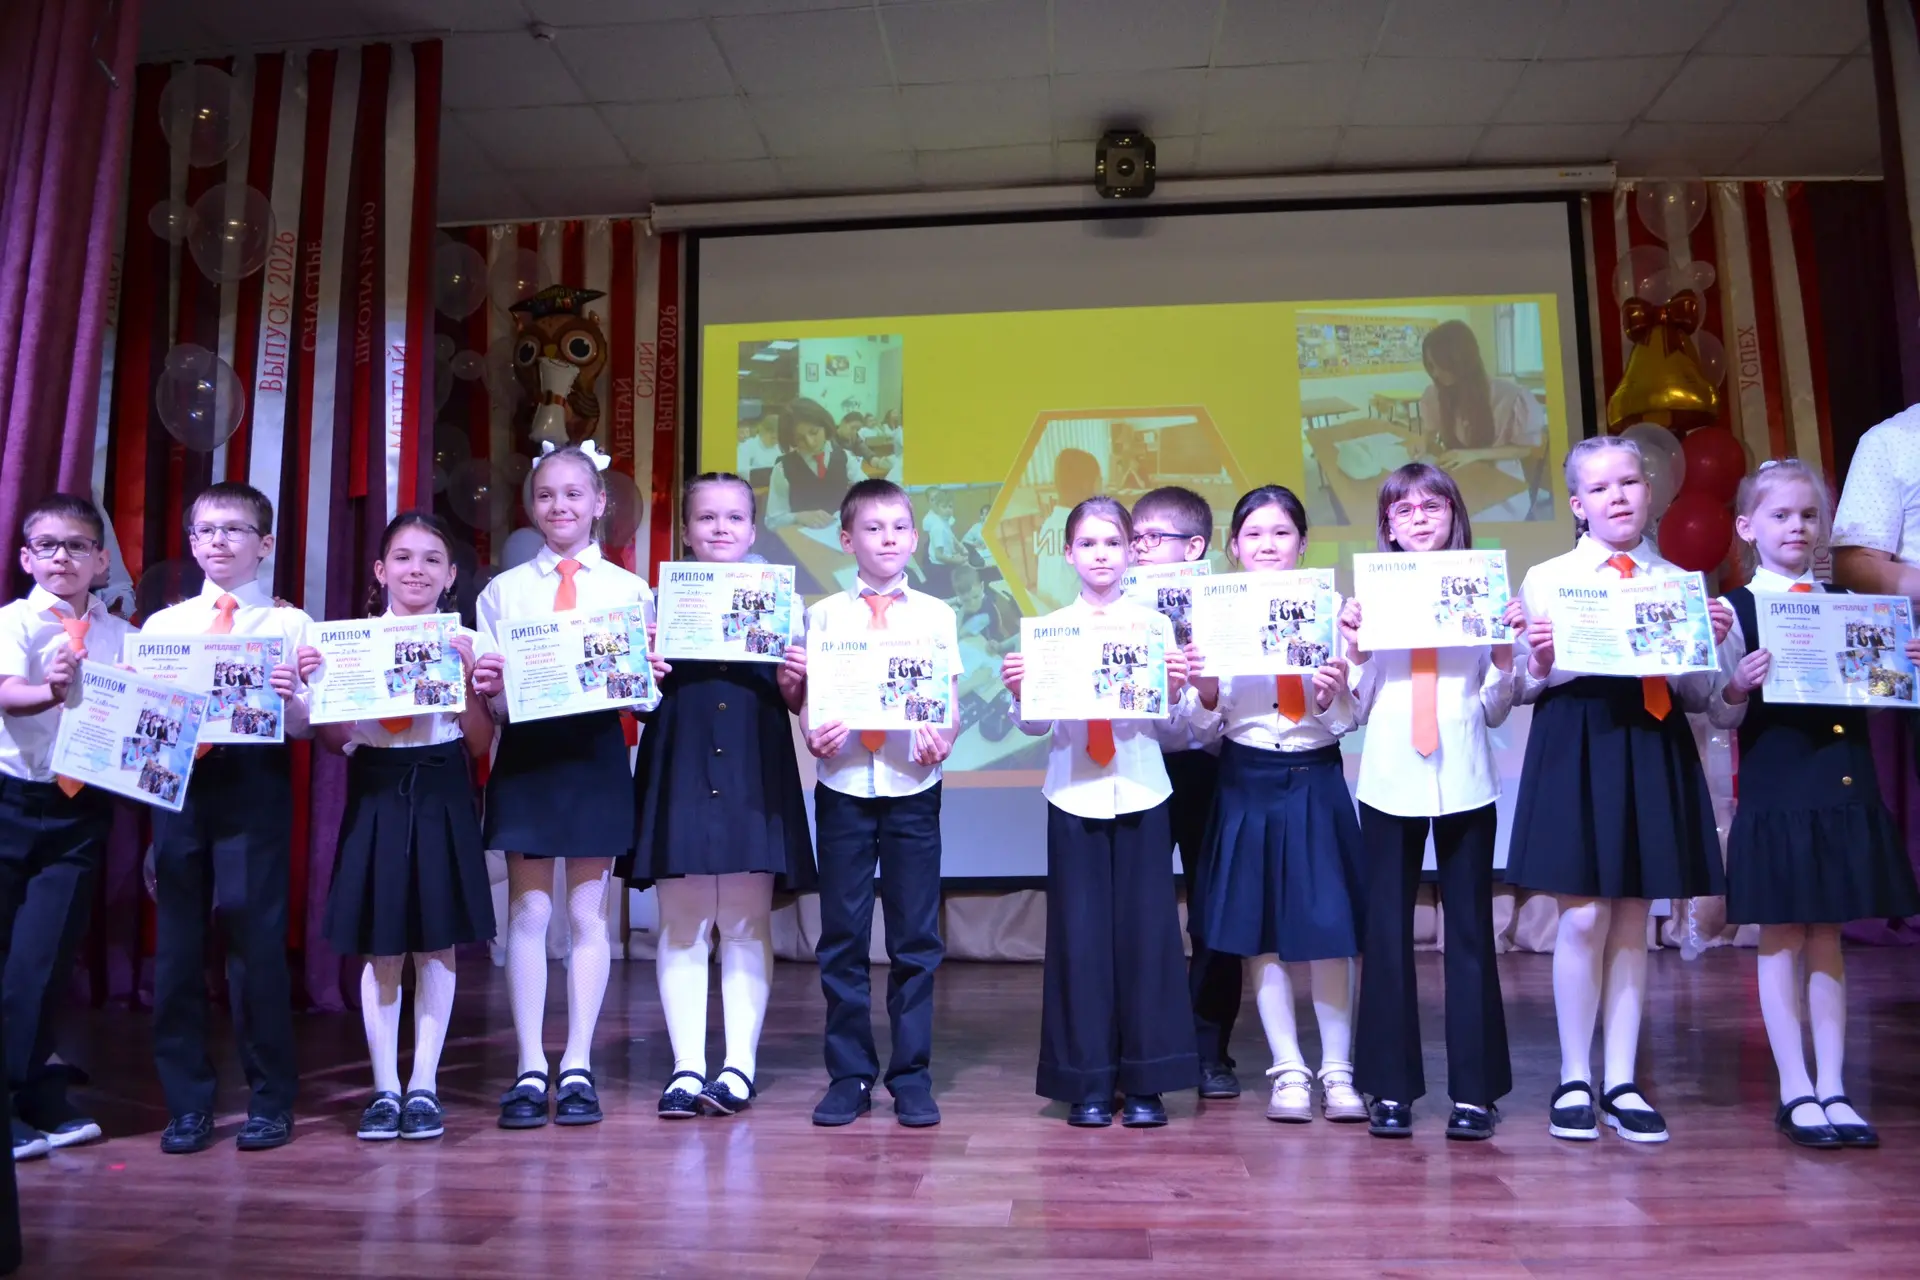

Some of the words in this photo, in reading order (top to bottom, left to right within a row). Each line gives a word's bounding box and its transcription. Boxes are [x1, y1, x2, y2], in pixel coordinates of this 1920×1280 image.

[267, 231, 296, 286] 2026
[659, 304, 677, 349] 2026
[258, 294, 290, 394] ВЫПУСК
[1737, 325, 1760, 390] УСПЕХ
[636, 341, 655, 398] СИЯЙ
[655, 352, 676, 432] ВЫПУСК
[613, 376, 633, 458] МЕЧТАЙ
[671, 572, 714, 583] ДИПЛОМ
[1204, 584, 1247, 596] ДИПЛОМ
[1559, 588, 1608, 598] ДИПЛОМ
[1771, 603, 1820, 616] ДИПЛОМ
[321, 629, 371, 643] ДИПЛОМ
[511, 624, 559, 641] ДИПЛОМ
[1034, 627, 1080, 640] ДИПЛОМ
[138, 644, 191, 657] ДИПЛОМ
[83, 672, 127, 694] ДИПЛОМ
